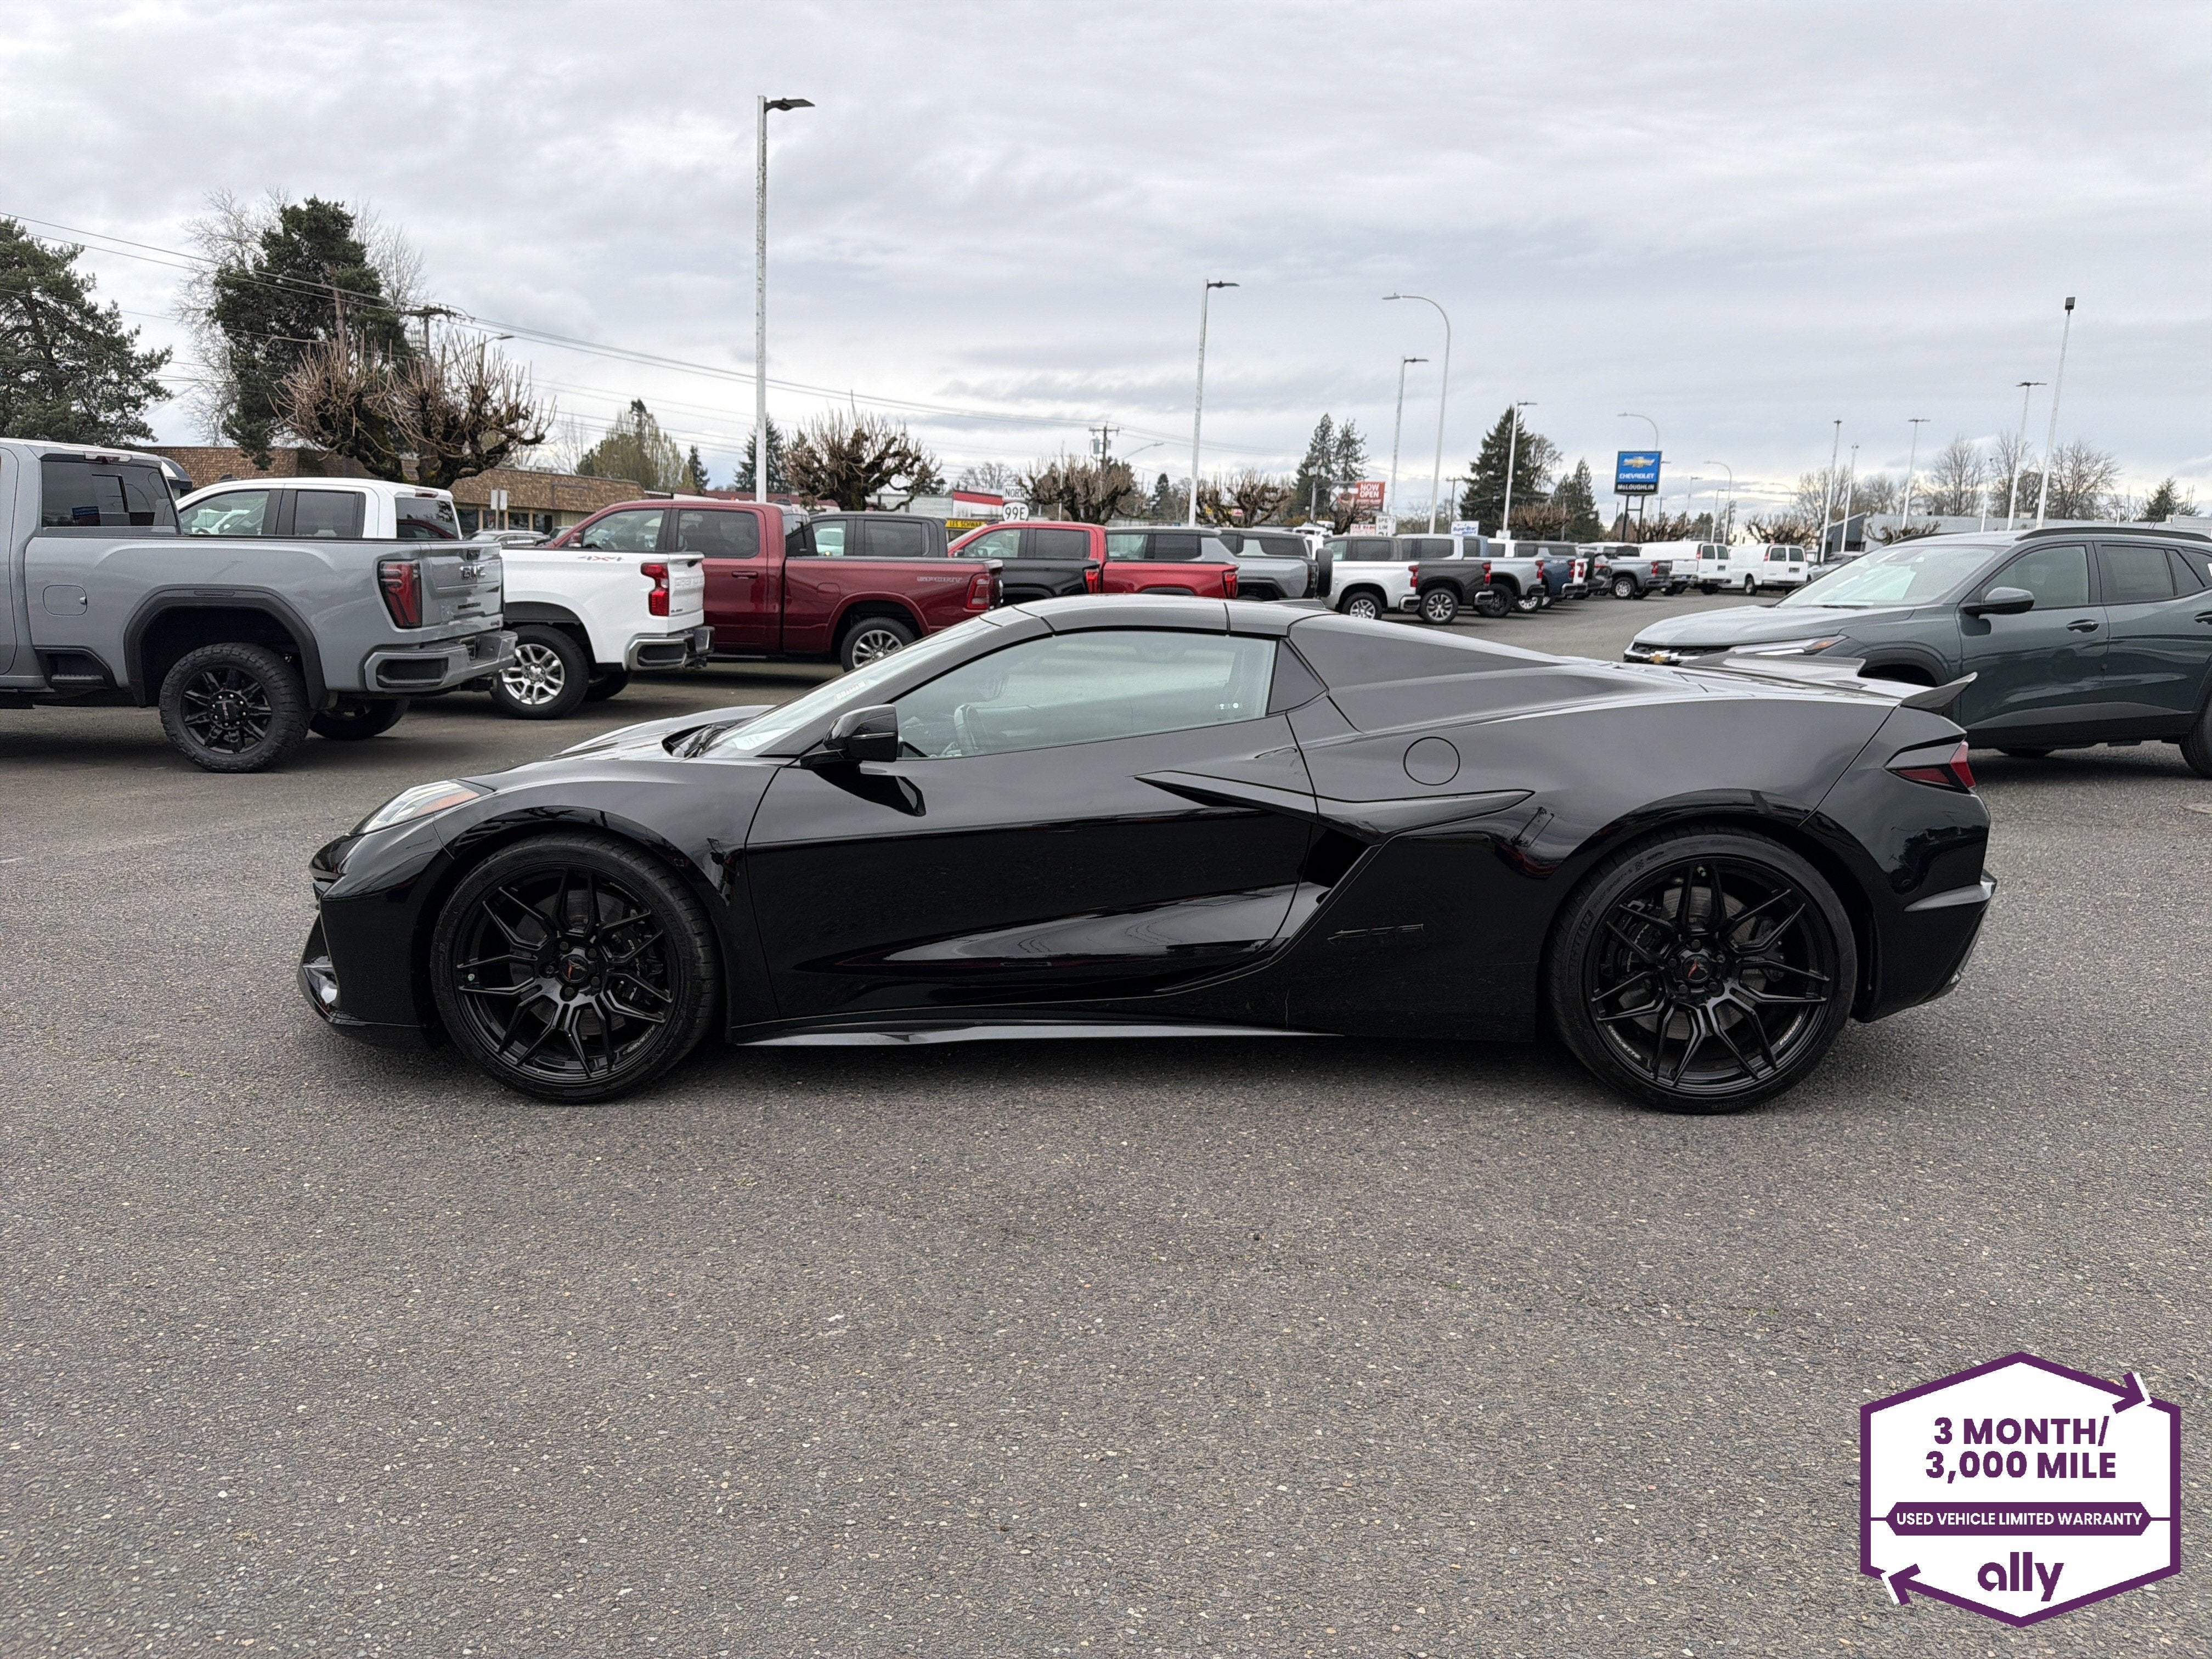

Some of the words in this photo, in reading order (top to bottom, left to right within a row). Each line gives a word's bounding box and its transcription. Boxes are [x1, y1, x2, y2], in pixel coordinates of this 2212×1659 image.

[1361, 483, 1379, 492] NOW
[1005, 488, 1025, 498] NORT
[1005, 506, 1025, 520] 99E
